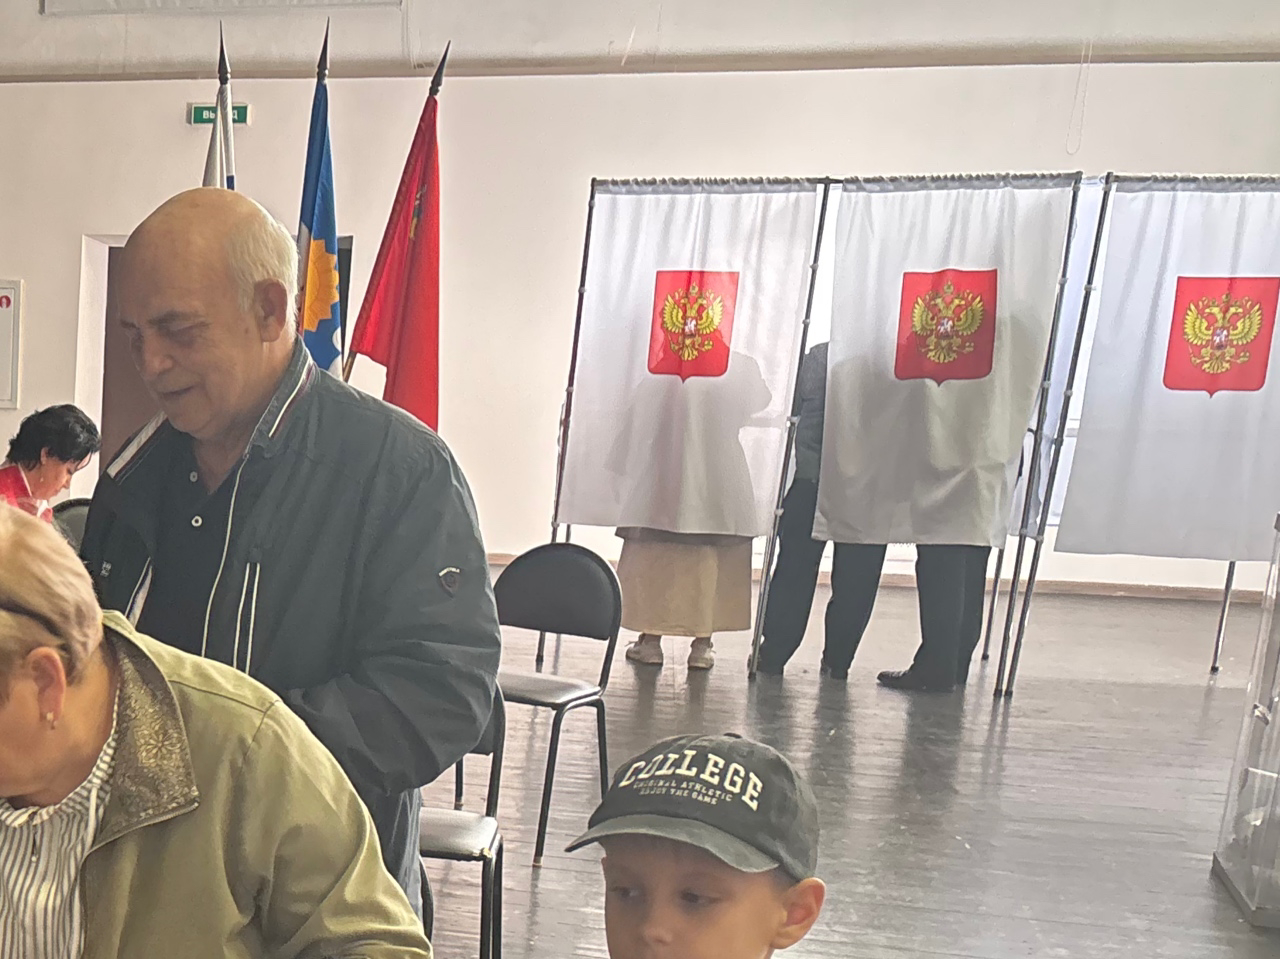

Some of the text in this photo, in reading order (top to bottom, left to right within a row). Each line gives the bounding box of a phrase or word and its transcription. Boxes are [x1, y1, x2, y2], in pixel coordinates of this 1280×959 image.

[202, 109, 238, 120] ВЫД
[618, 749, 764, 812] COLLEGE
[680, 781, 734, 802] ATHLETIC
[692, 792, 718, 805] GAME
